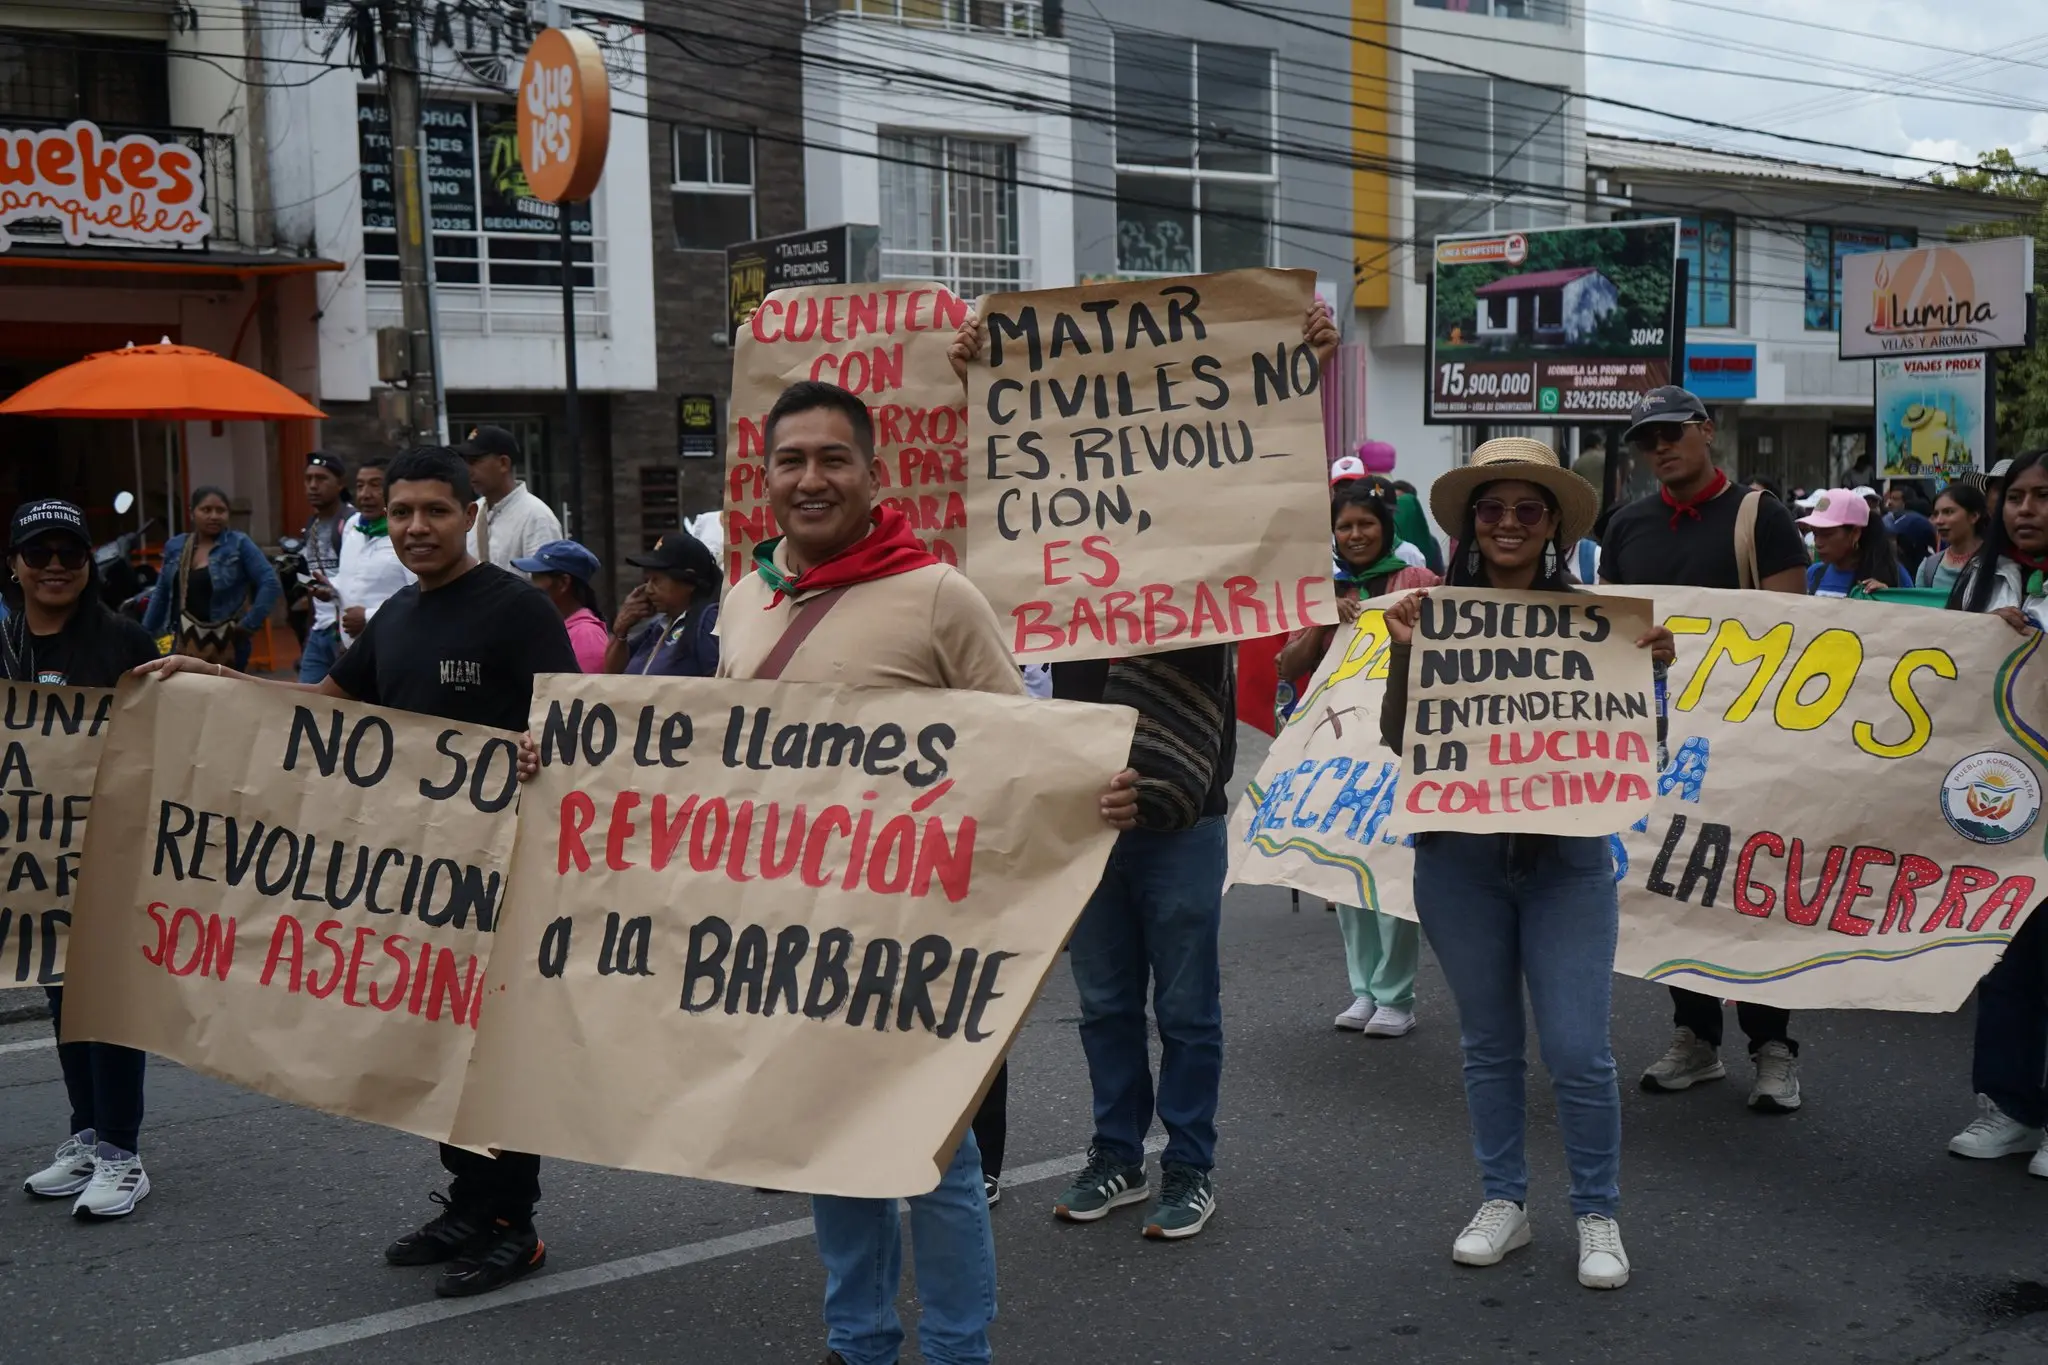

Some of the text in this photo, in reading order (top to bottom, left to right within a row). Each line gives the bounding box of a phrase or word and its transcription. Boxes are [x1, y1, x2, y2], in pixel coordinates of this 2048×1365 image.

[781, 241, 828, 258] TATUAJES
[783, 262, 829, 277] PIERCING
[752, 289, 969, 344] CUENTEN
[989, 285, 1208, 372] MATAR
[1630, 328, 1665, 345] 30M2
[1881, 333, 1978, 350] VELAS Y AROMAS
[809, 343, 903, 396] CON
[987, 341, 1320, 427] CIVILES NO
[1440, 363, 1531, 398] 15,900,000
[1903, 359, 1982, 373] VIAJES PROEX
[1043, 534, 1121, 589] ES
[1012, 575, 1327, 656] BARBARIE
[1420, 598, 1611, 642] USTEDES
[440, 660, 481, 685] MIAMI
[1421, 647, 1594, 689] NUNCA
[540, 698, 618, 767] NO
[1415, 691, 1648, 735] ENTENDERIAN
[282, 704, 521, 815] NO SO
[1413, 730, 1650, 775] LA LUCHA
[1405, 771, 1653, 814] COLECTIVA
[1646, 814, 1732, 908] LA
[1733, 831, 2036, 937] GUERRA
[141, 901, 488, 1031] SON ASESIN
[680, 915, 1019, 1043] BARBARIE
